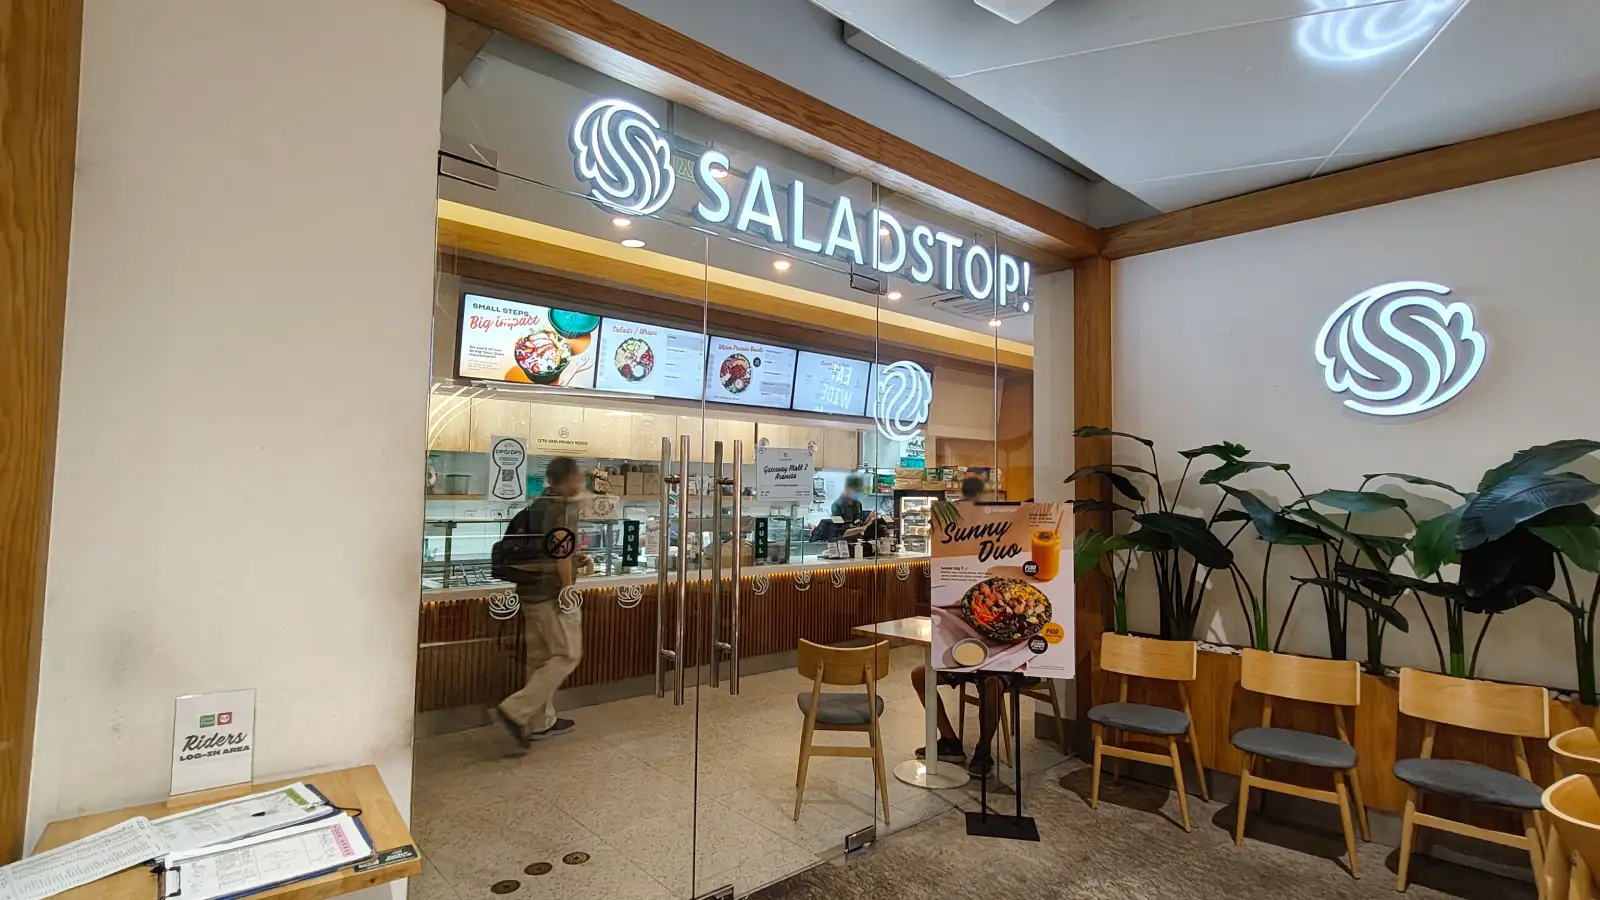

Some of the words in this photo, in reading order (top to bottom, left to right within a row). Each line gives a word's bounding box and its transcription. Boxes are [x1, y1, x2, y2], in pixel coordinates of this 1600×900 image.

[697, 150, 1031, 313] SALADSTOP!
[473, 302, 501, 312] SMALL
[502, 308, 529, 317] STEPS
[469, 315, 493, 332] Big
[495, 315, 540, 330] impact
[612, 326, 633, 334] Salads
[639, 328, 657, 336] Wraps
[763, 465, 787, 475] Gateway
[788, 464, 803, 472] Mall
[804, 463, 809, 471] 2
[940, 520, 1013, 544] Sunny
[626, 525, 635, 562] PULL
[977, 540, 1023, 563] Duo
[182, 732, 248, 752] Riders
[180, 750, 221, 761] LOG-IN
[222, 745, 250, 755] AREA
